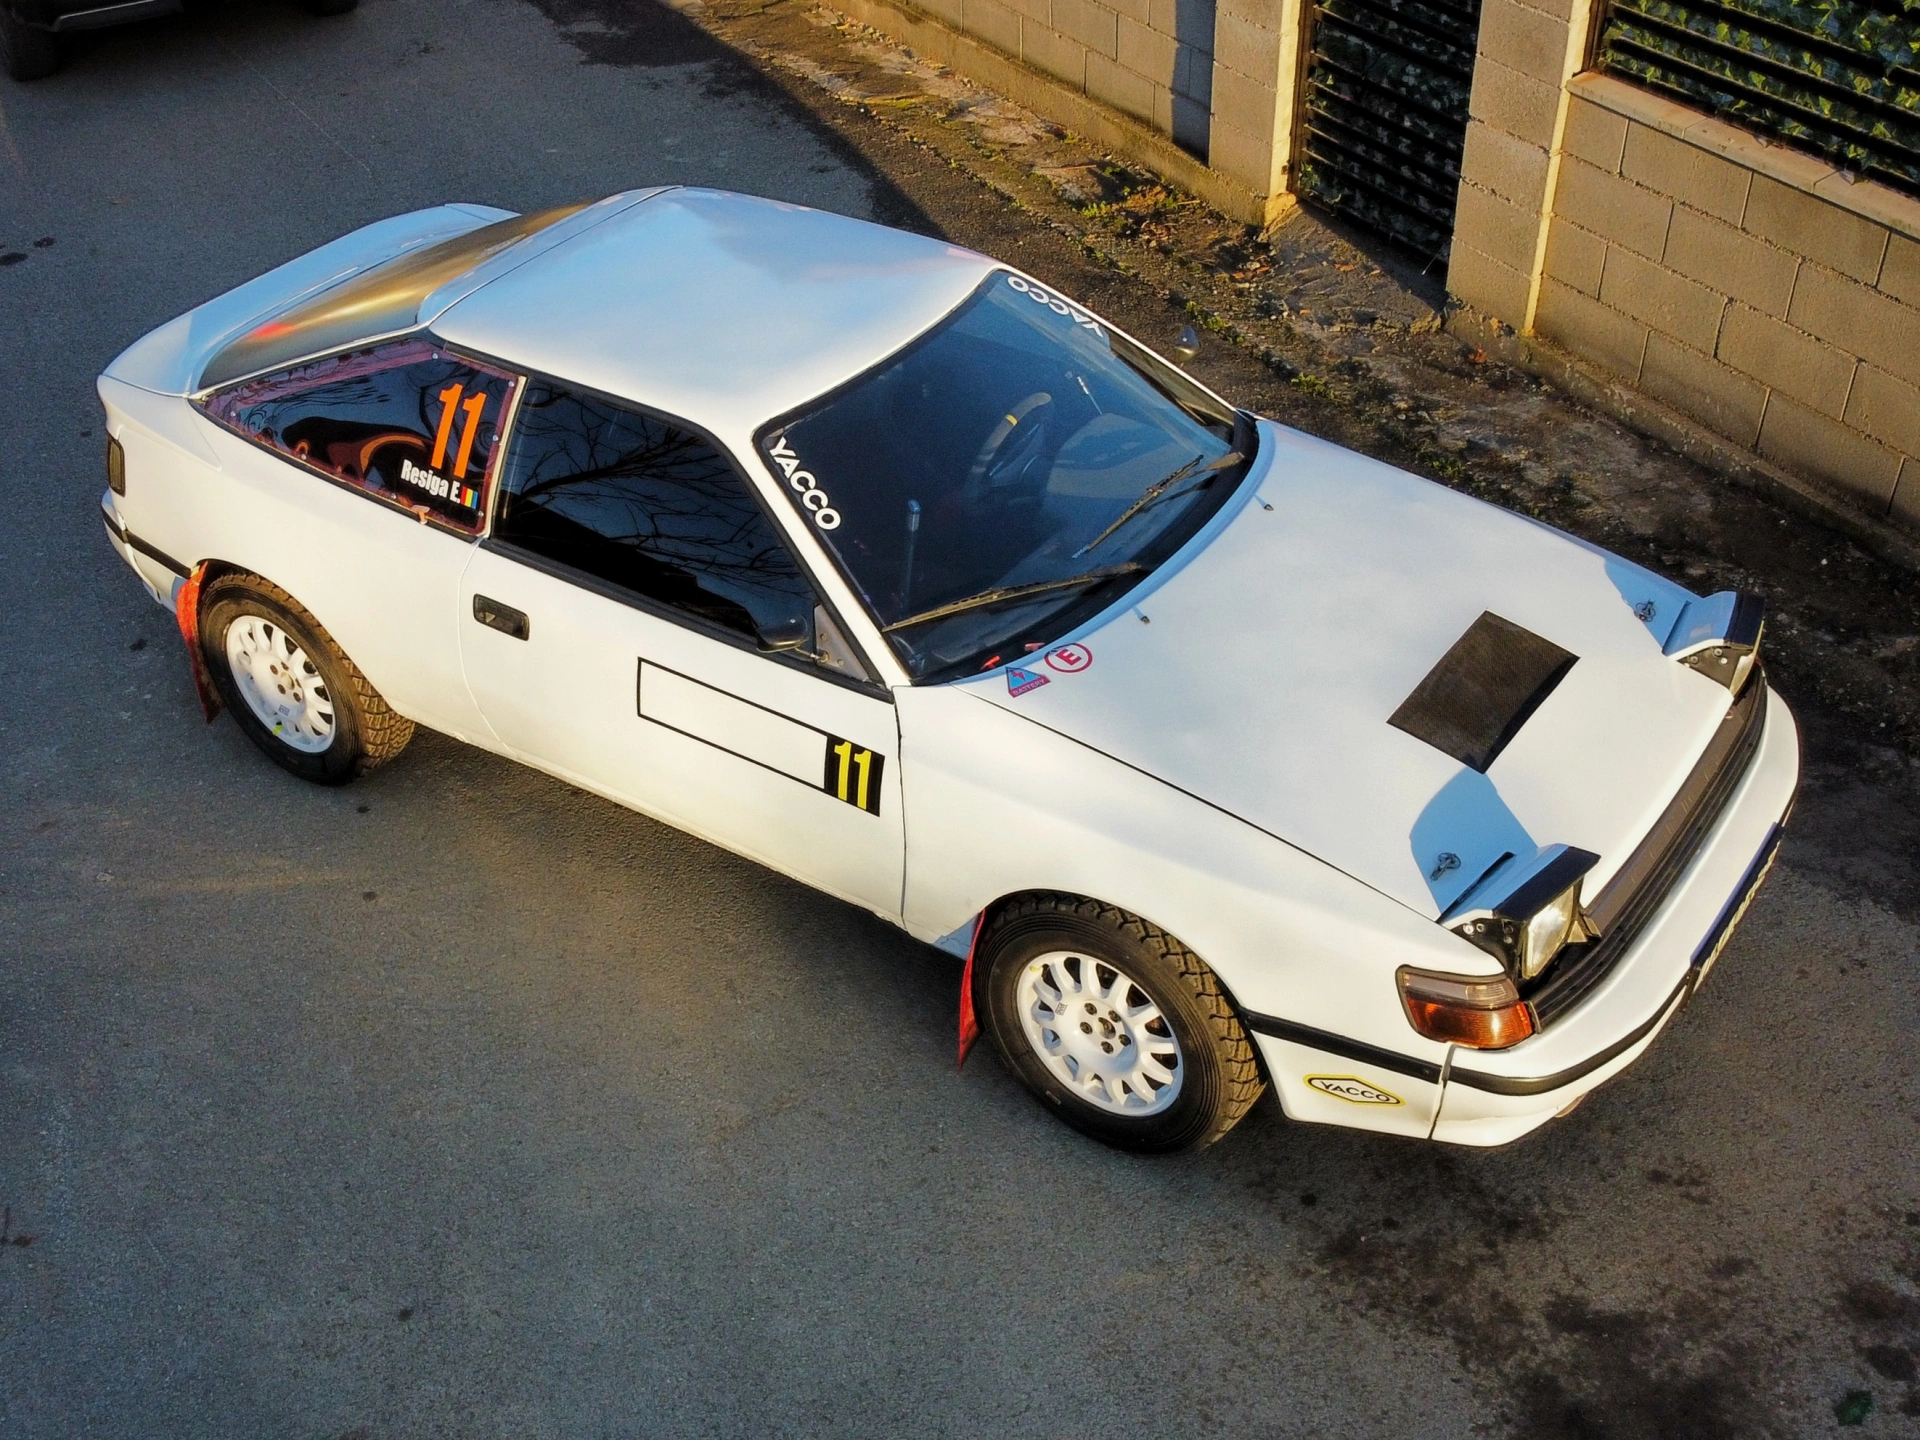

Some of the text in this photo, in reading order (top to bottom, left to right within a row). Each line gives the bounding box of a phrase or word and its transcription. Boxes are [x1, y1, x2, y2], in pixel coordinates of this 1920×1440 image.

[1007, 276, 1103, 338] YACCO
[431, 383, 487, 479] 11
[401, 459, 449, 498] Resiga
[769, 436, 841, 530] YACCO
[1056, 648, 1082, 666] E
[834, 741, 871, 810] 11
[1320, 1081, 1390, 1102] YACCO
